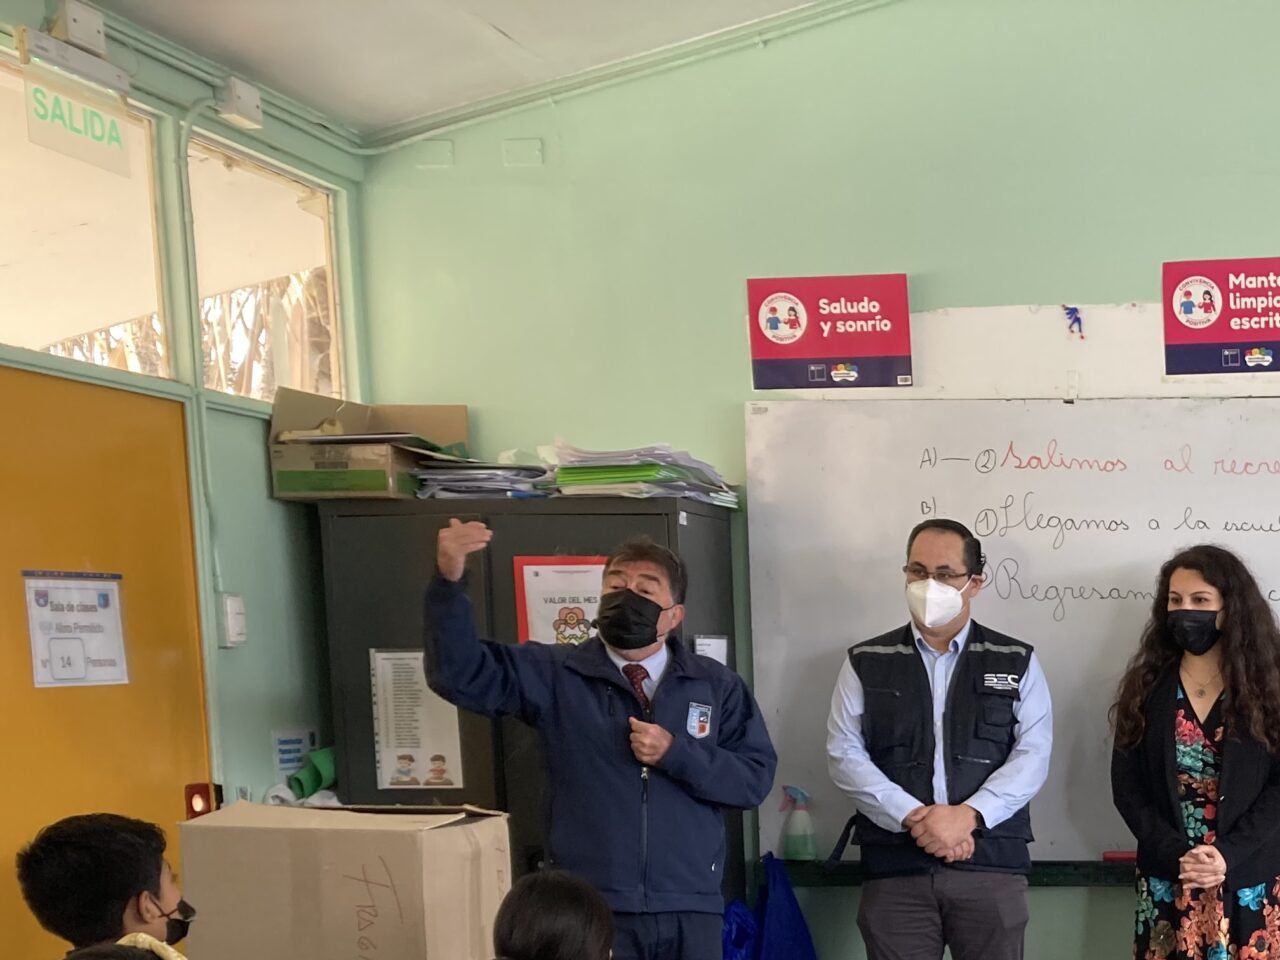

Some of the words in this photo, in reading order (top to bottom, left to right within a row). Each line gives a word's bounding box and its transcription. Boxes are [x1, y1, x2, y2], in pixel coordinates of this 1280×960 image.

[32, 86, 123, 149] SALIDA
[1178, 278, 1215, 292] CONVIVENCIA
[818, 296, 880, 315] Saludo
[820, 320, 831, 337] y
[836, 315, 892, 333] sonrío
[1185, 317, 1212, 326] POSITIVA
[1000, 439, 1128, 473] Salimos
[1163, 444, 1195, 473] al
[999, 491, 1129, 550] Llegamos
[1148, 516, 1161, 531] a
[1174, 507, 1211, 532] la
[49, 601, 65, 612] Sala
[60, 656, 72, 668] 14
[984, 673, 1019, 686] SEC
